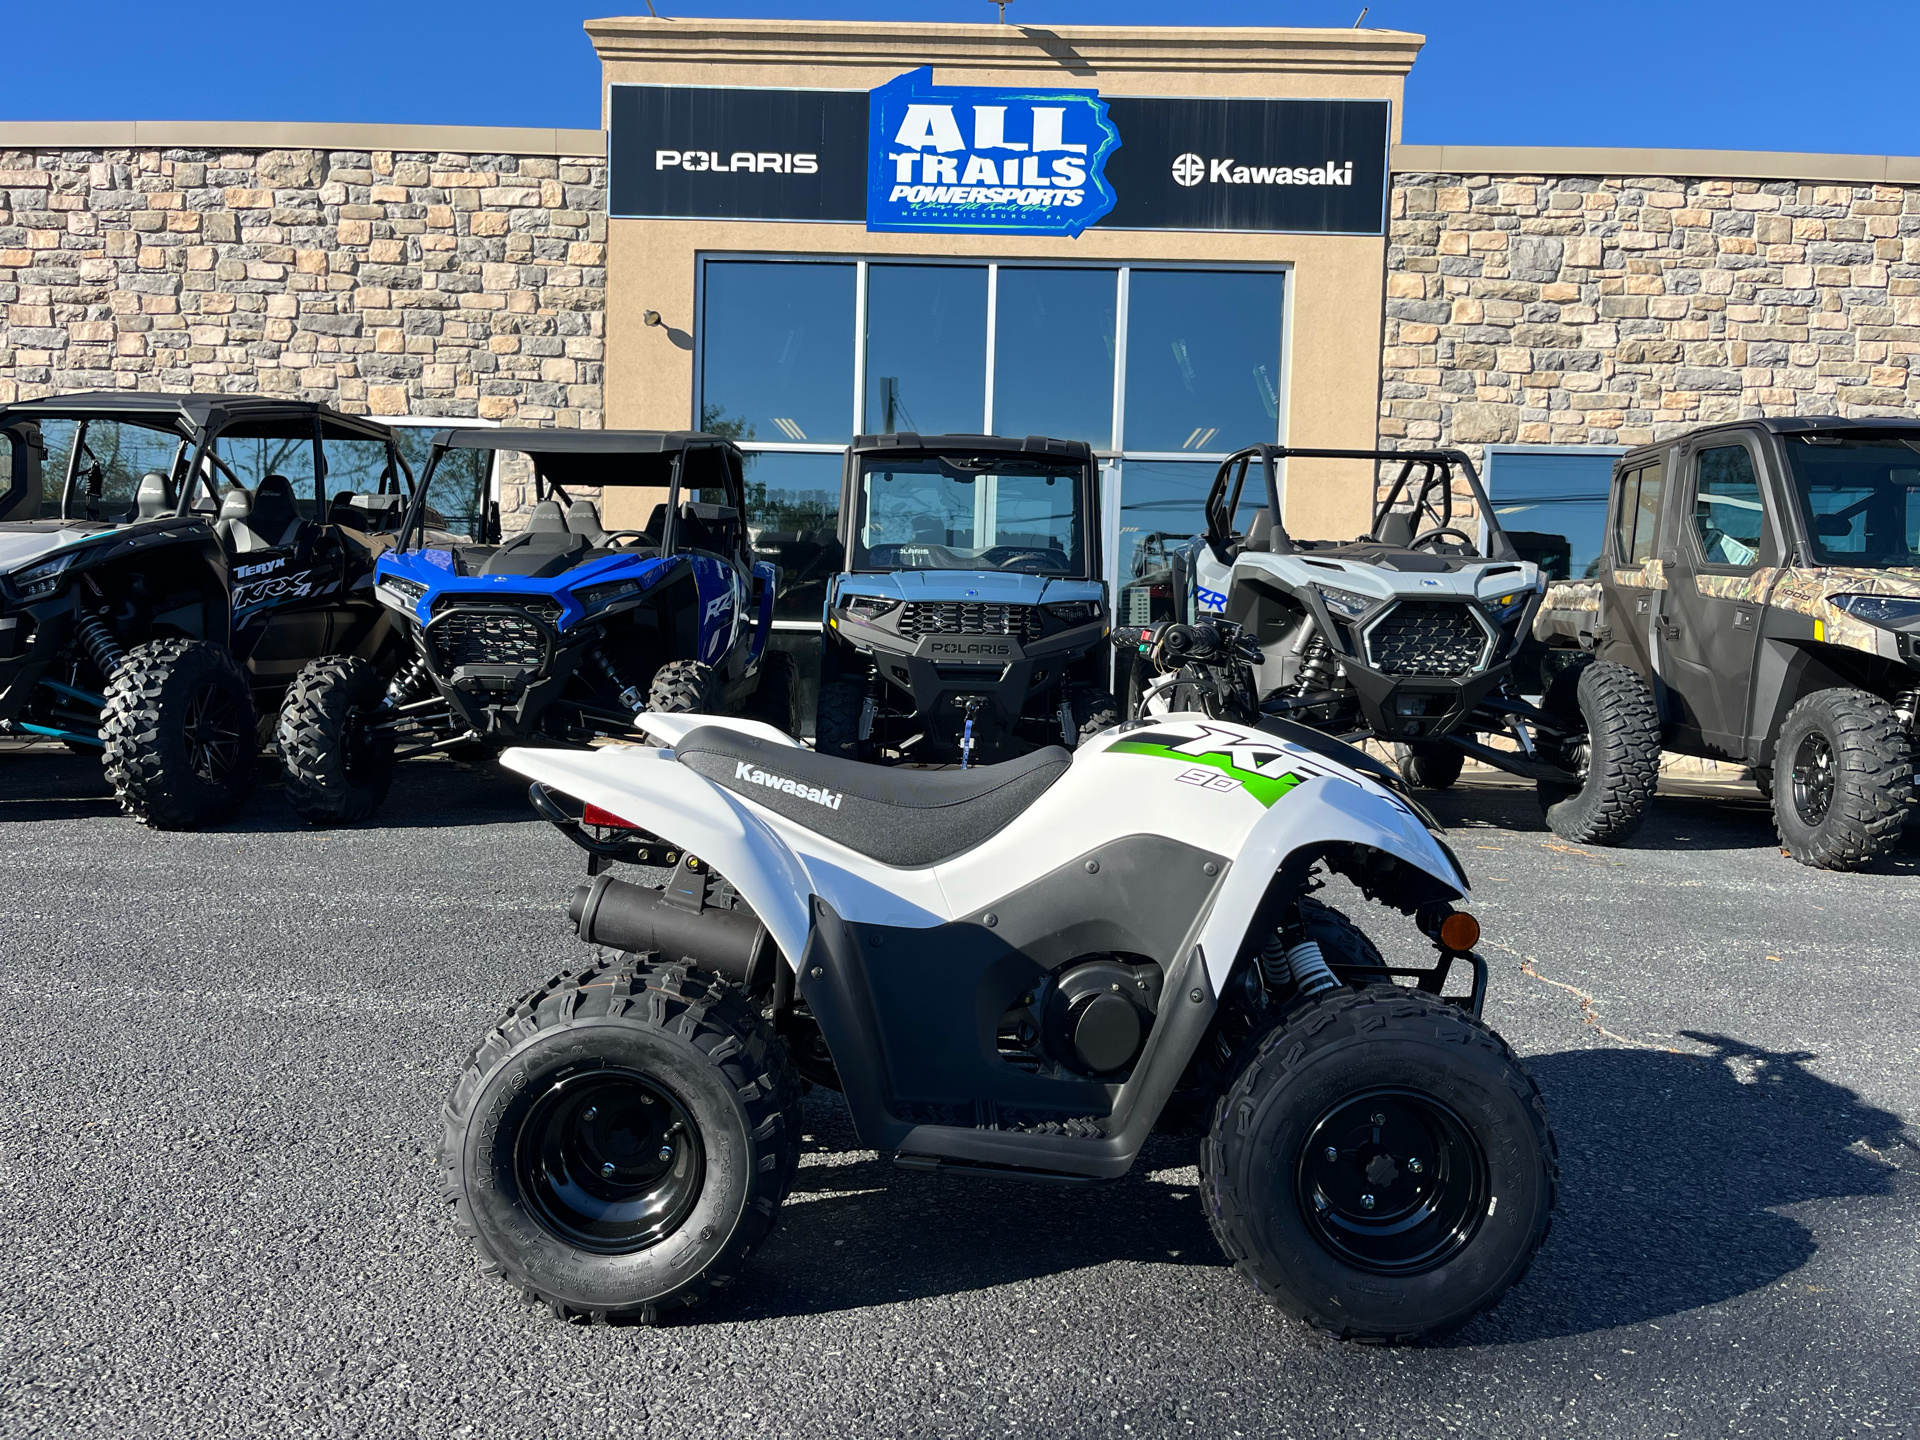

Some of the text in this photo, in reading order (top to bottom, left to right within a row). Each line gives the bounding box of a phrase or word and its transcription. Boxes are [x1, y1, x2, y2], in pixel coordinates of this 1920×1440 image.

[894, 104, 1087, 156] ALL
[656, 150, 818, 173] POLARIS
[889, 153, 1086, 187] TRAILS
[1210, 159, 1352, 185] Kawasaki
[889, 185, 1083, 207] POWERSPORTS
[891, 547, 929, 555] POLARIS
[234, 570, 312, 610] KRX 4
[1781, 578, 1824, 592] XP
[1782, 588, 1811, 601] 1000
[704, 588, 735, 626] RZ
[931, 643, 1010, 656] POLARIS
[735, 761, 842, 811] Kawasaki
[1175, 768, 1245, 793] 90
[478, 1070, 530, 1190] MAXXIS
